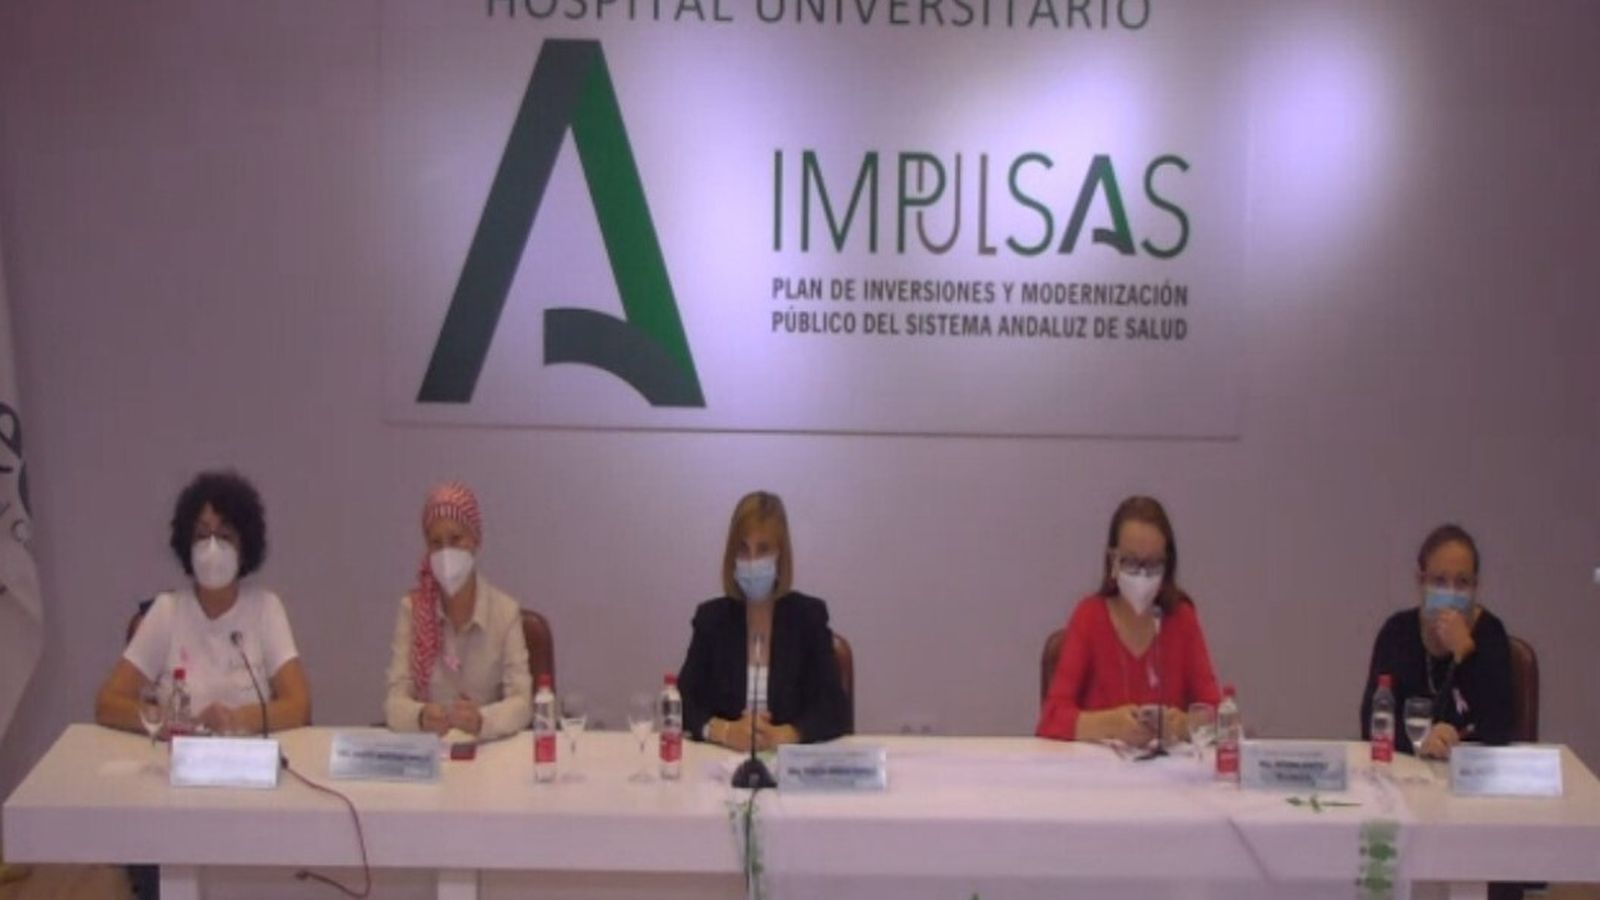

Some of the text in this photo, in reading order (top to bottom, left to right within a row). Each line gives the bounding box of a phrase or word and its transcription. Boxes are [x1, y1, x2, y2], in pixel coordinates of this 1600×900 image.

[756, 0, 1151, 30] UNIVERSITARIO
[773, 150, 1191, 258] IMPULSAS
[772, 277, 1189, 307] PLAN DE INVERSIONES Y MODERNIZACIÓN
[771, 305, 1189, 341] PÚBLICO DEL SISTEMA ANDALUZ DE SALUD
